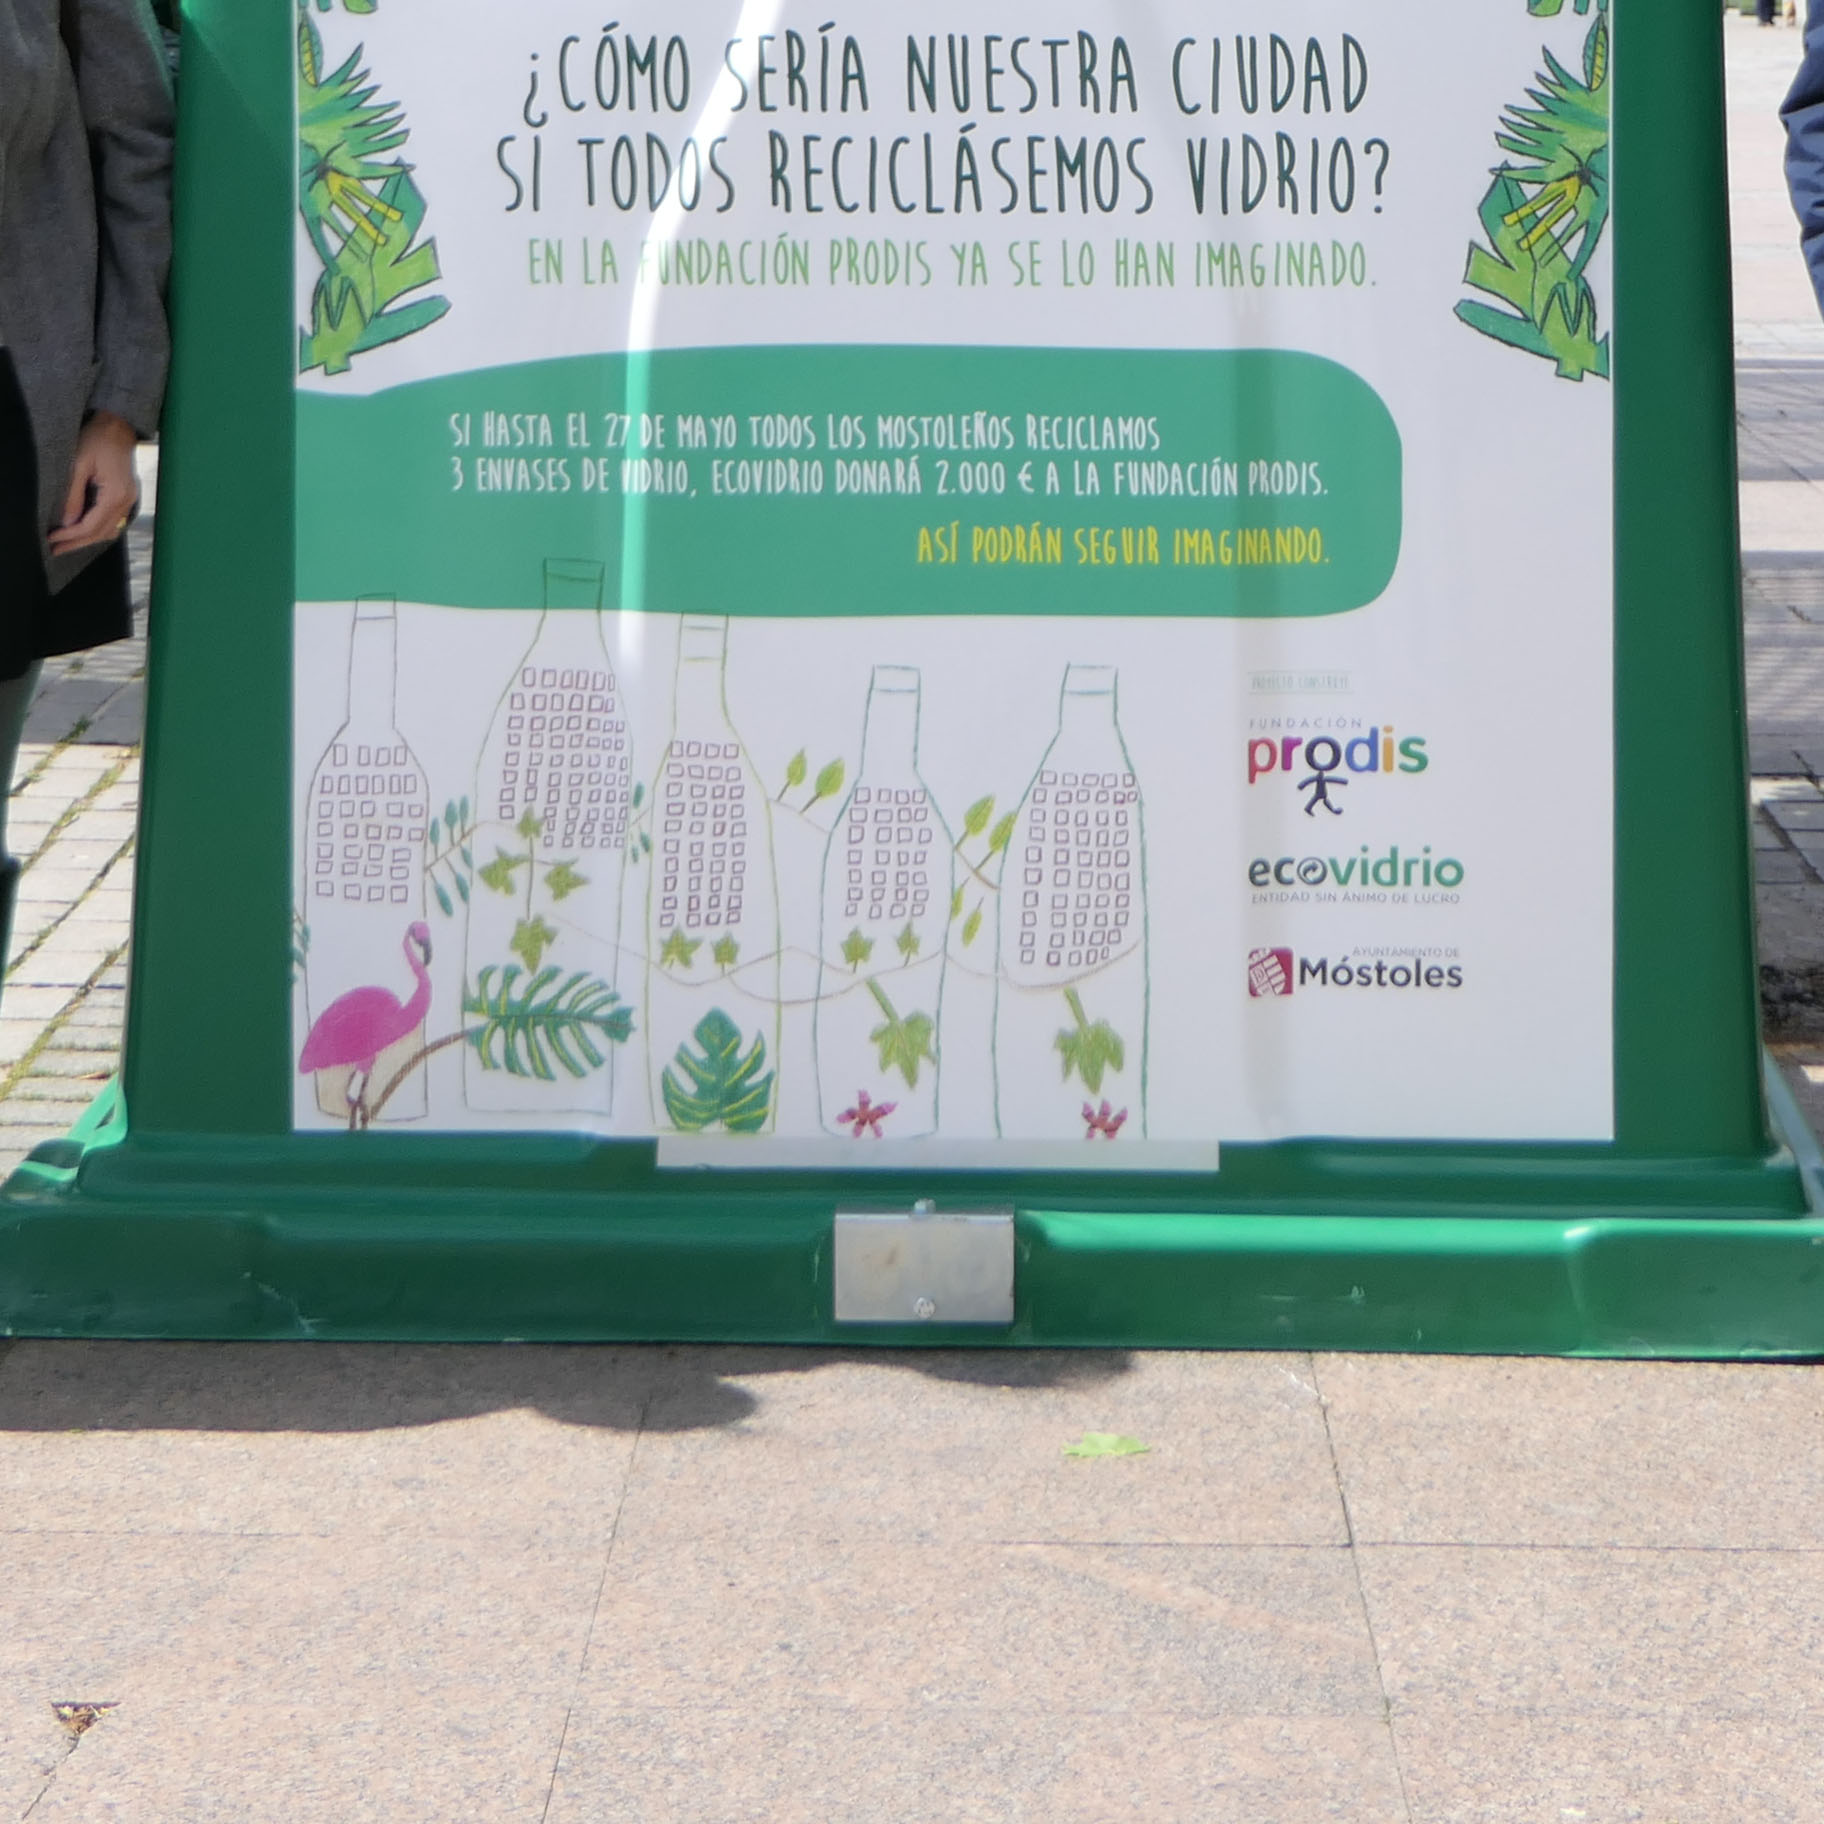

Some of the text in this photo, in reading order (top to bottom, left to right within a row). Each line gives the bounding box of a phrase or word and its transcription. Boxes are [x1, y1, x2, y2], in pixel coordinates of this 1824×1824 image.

[523, 21, 1368, 128] ¿CÓMO SERÍA NUESTRA CIUDAD
[497, 122, 1391, 215] SI TODOS RECICLÁSEMOS VIDRIO?
[529, 233, 1378, 288] EN LA FUNDACIÓN PRODIS YA SE LO HAN IMAGINADO.
[449, 410, 1161, 451] SI HASTA EL 27 DE MAYO TODOS LOS MOSTOLEÑOS RECICLAMOS
[450, 454, 1329, 498] 3 ENVASES DE VIDRIO, ECOVIDRIO DONARÁ 2.000 € A LA FUNDACIÓN PRODIS.
[917, 520, 1330, 566] ASÍ PODRÁN SEGUIR IMAGINANDO.
[1249, 715, 1363, 730] FUNDACIÓN
[1247, 725, 1430, 785] prodis
[1247, 844, 1465, 888] ecovidrio
[1252, 890, 1461, 905] ENTIDAD SIN ÁNIMO DE LUCRO
[1298, 956, 1464, 988] Móstoles
[1352, 945, 1460, 958] AYUNTAMIENTO DE
